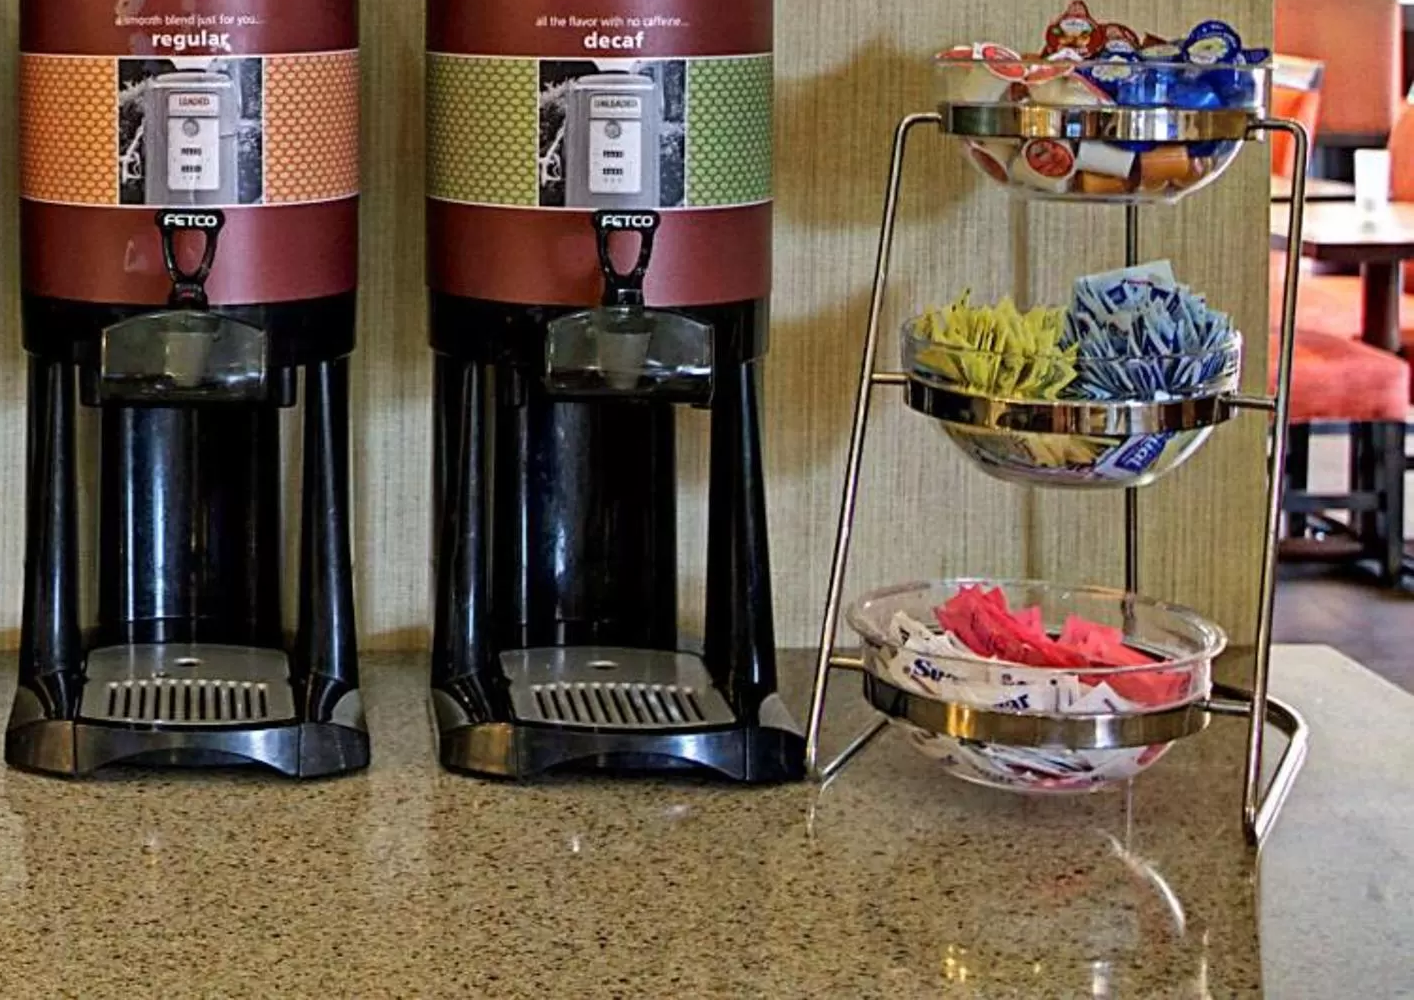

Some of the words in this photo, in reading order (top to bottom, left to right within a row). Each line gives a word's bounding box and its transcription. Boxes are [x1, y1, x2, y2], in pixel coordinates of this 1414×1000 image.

[124, 14, 163, 25] smooth
[165, 13, 195, 26] blend
[196, 14, 217, 27] just
[219, 13, 235, 25] for
[536, 15, 548, 27] all
[550, 16, 567, 27] the
[569, 15, 598, 28] flavor
[600, 15, 624, 28] with
[626, 17, 641, 27] no
[151, 29, 232, 51] regular
[583, 30, 645, 49] decaf
[163, 213, 218, 227] FETCO
[601, 215, 655, 228] FETCO
